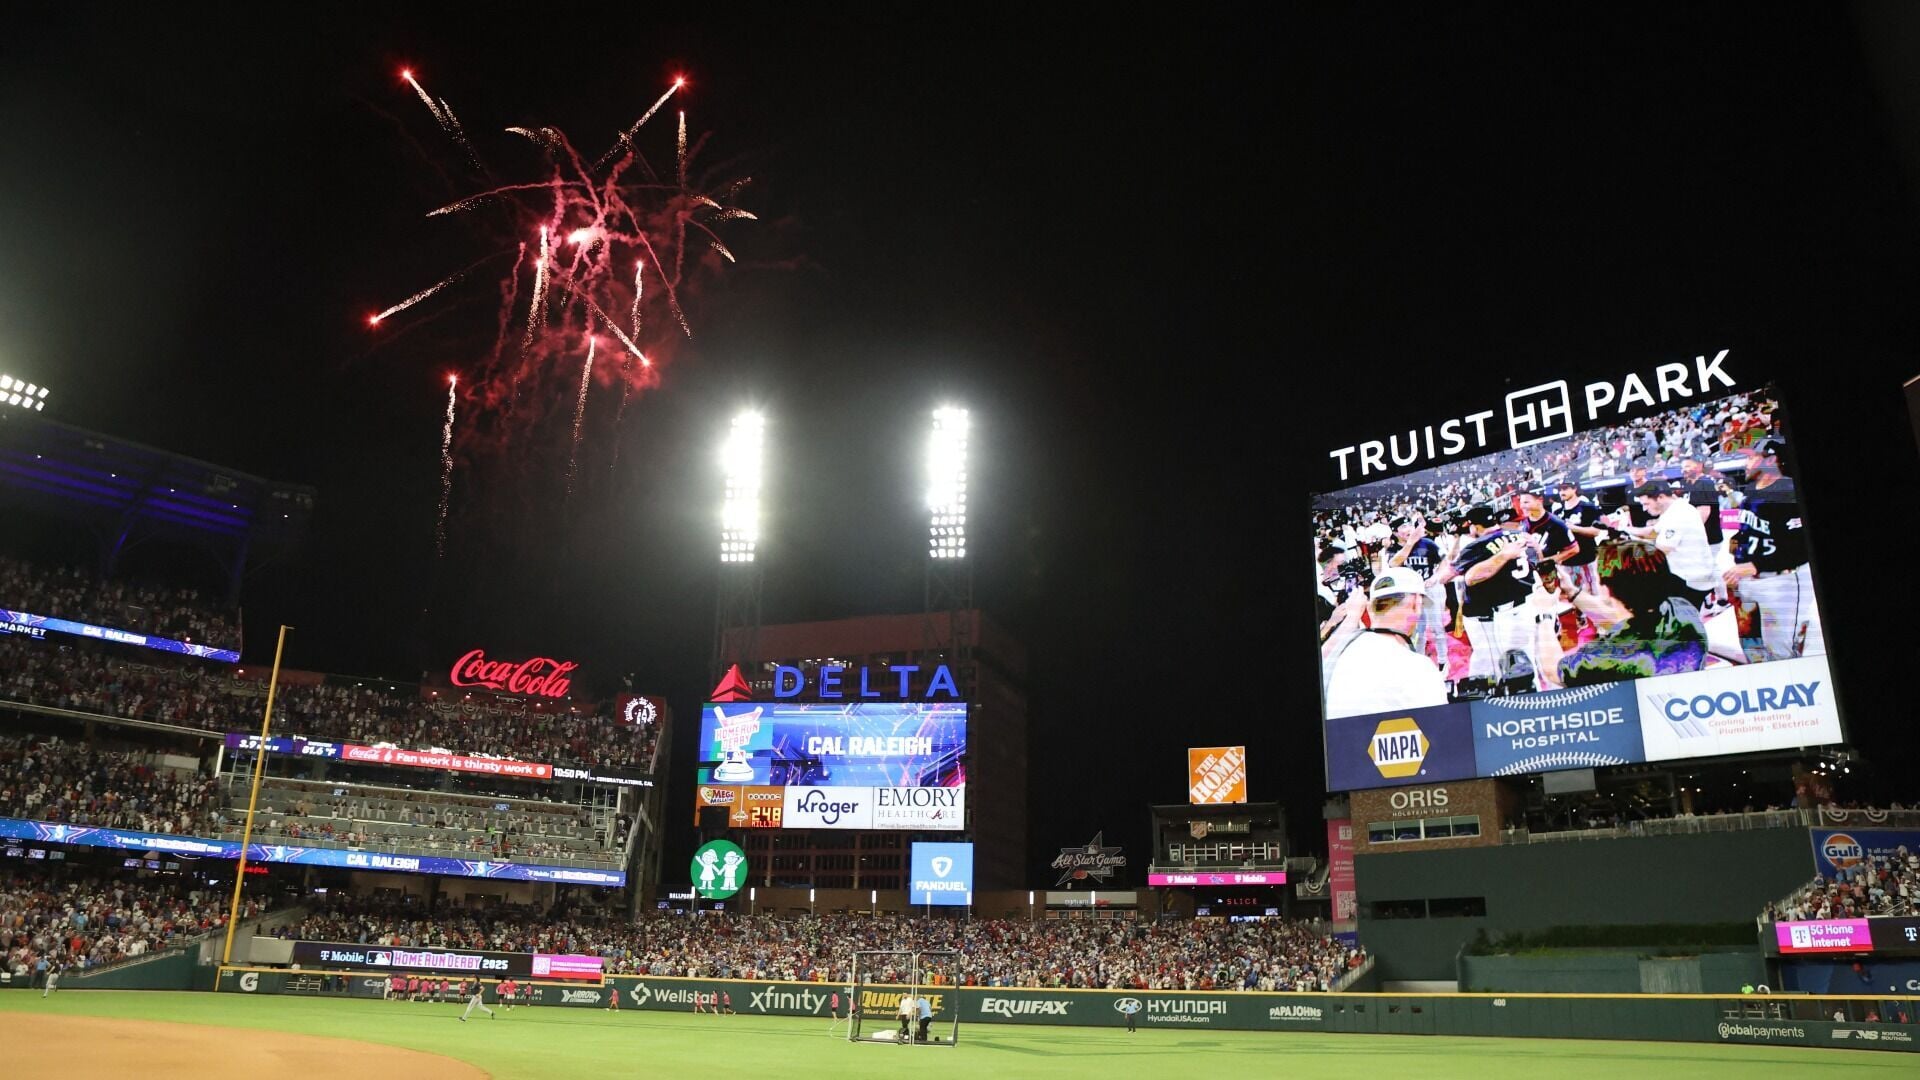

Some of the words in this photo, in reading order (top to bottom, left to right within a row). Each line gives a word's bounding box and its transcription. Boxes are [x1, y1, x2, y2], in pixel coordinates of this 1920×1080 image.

[1330, 410, 1494, 480] TRUIST
[1585, 350, 1737, 420] PARK
[1747, 536, 1777, 556] 75
[0, 622, 46, 636] MARKET
[83, 626, 103, 637] CAL
[451, 650, 578, 698] Coca-Cola
[775, 665, 959, 698] DELTA
[1665, 681, 1821, 722] COOLRAY
[1486, 707, 1624, 738] NORTHSIDE
[1708, 718, 1745, 728] Cooling
[1753, 713, 1792, 723] Heating
[1719, 725, 1764, 735] Plumbing
[1772, 718, 1819, 731] Electrical
[239, 740, 257, 749] 3.9
[808, 737, 848, 755] CAL
[852, 736, 932, 755] RALEIGH
[1378, 734, 1420, 761] NAPA
[1512, 731, 1600, 750] HOSPITAL
[302, 746, 323, 755] 81.6
[396, 753, 418, 763] Fan
[420, 757, 449, 766] work
[452, 759, 462, 768] is
[464, 761, 501, 773] thirsty
[503, 765, 532, 775] work
[1195, 753, 1218, 777] THE
[554, 768, 575, 778] 10:50
[575, 771, 588, 780] PM
[1190, 747, 1244, 804] HOME
[1211, 767, 1244, 803] DEPOT
[878, 788, 960, 807] EMORY
[1391, 788, 1449, 810] ORIS
[752, 806, 782, 821] 248
[797, 789, 859, 825] Kroger
[878, 808, 957, 820] HEALTHCARE
[751, 820, 781, 828] MILLION
[1207, 823, 1249, 832] CLUBHOUSE
[1825, 846, 1860, 858] Gulf
[346, 854, 368, 867] CAL
[371, 855, 420, 869] RALEIGH
[1052, 854, 1073, 868] All
[1073, 854, 1096, 867] Star
[1096, 854, 1125, 868] Game
[916, 881, 967, 891] FANDUEL
[1242, 875, 1266, 883] Mobile
[1810, 925, 1823, 935] 5G
[1825, 924, 1853, 934] Home
[1812, 936, 1851, 947] Internet
[331, 952, 364, 962] Mobile
[482, 958, 509, 970] 2025
[654, 988, 714, 1004] Wellstar
[750, 986, 828, 1015] xfinity
[1493, 998, 1506, 1007] 400
[981, 998, 1069, 1017] EQUIFAX
[1148, 1000, 1226, 1014] HYUNDAI
[1148, 1015, 1209, 1023] HyundaiUSA.com
